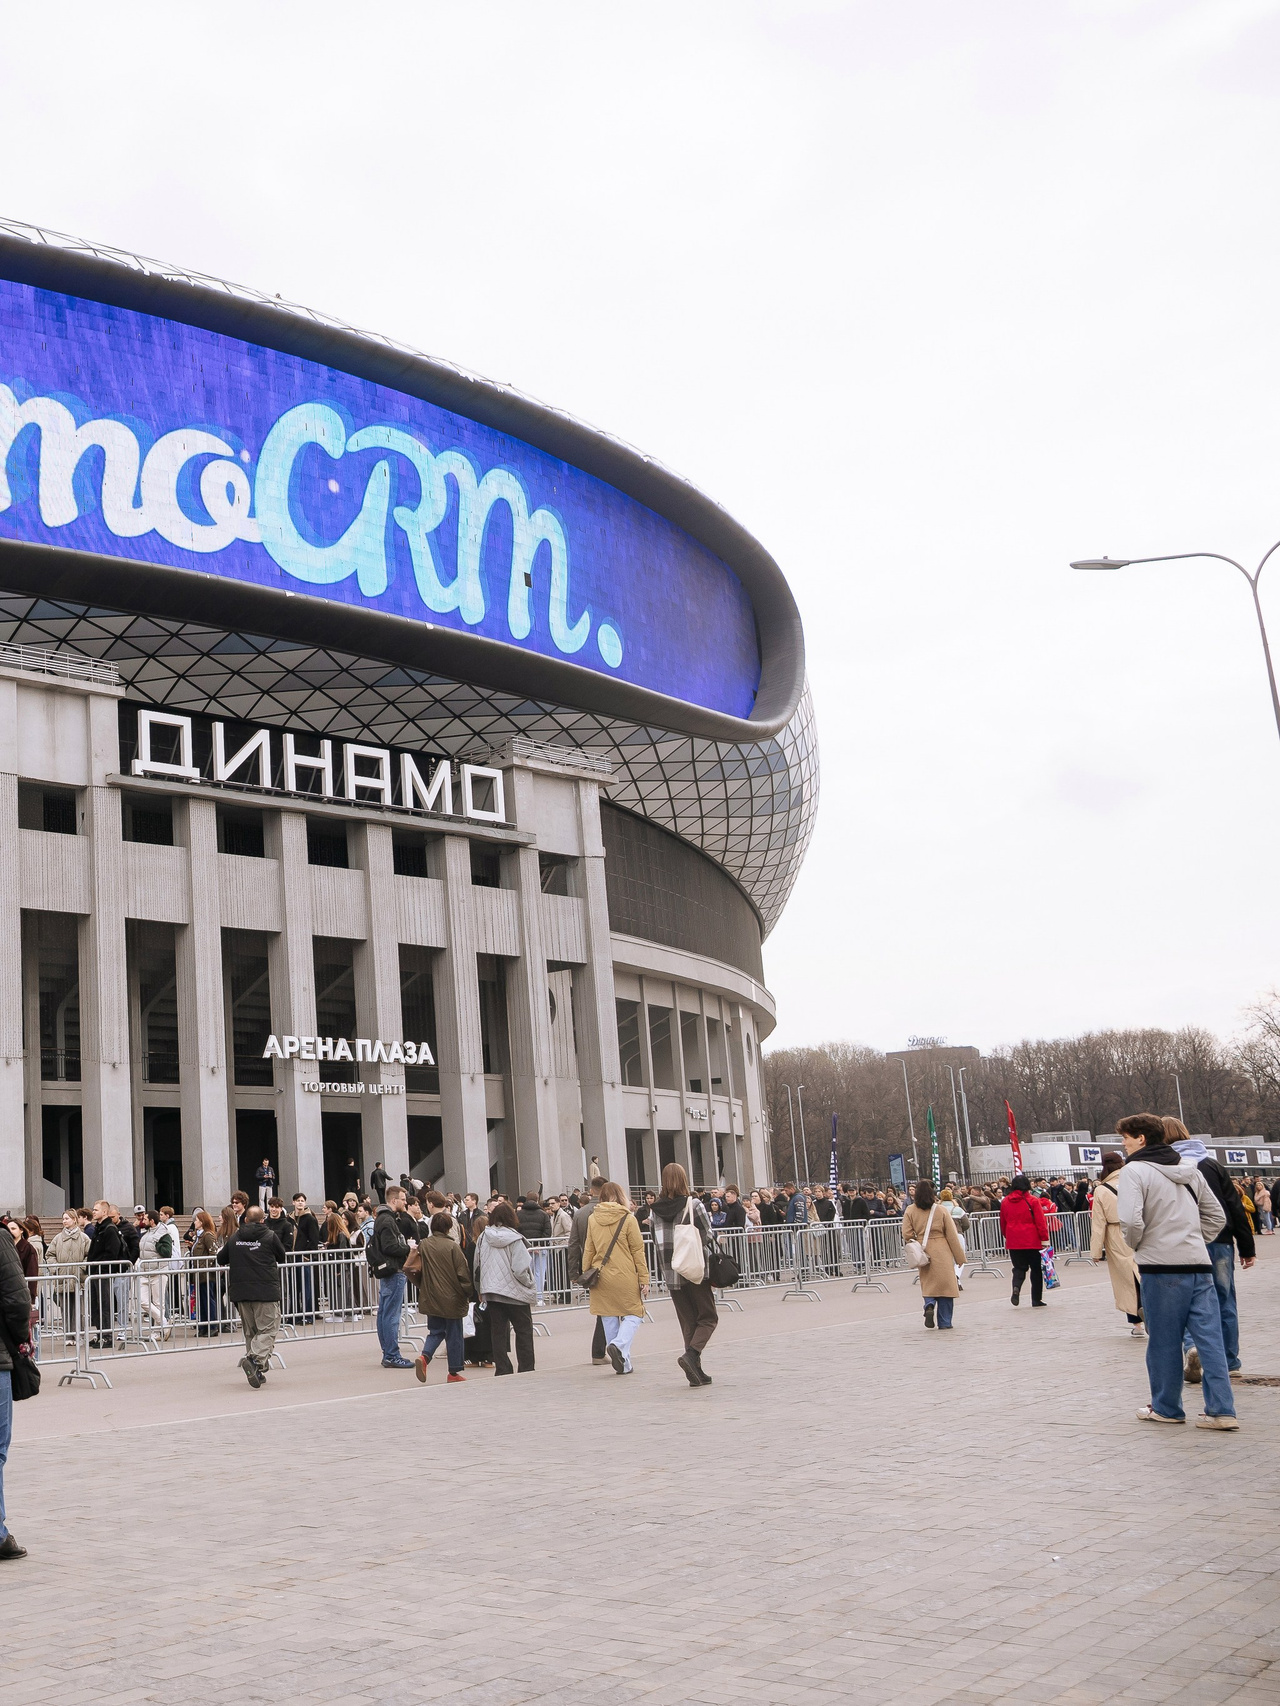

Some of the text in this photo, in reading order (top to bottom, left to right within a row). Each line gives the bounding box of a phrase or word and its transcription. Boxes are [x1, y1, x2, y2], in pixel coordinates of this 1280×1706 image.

[131, 708, 506, 824] ДИНАМО
[301, 1081, 406, 1096] ТОРГОВЫЙ ЦЕНТР
